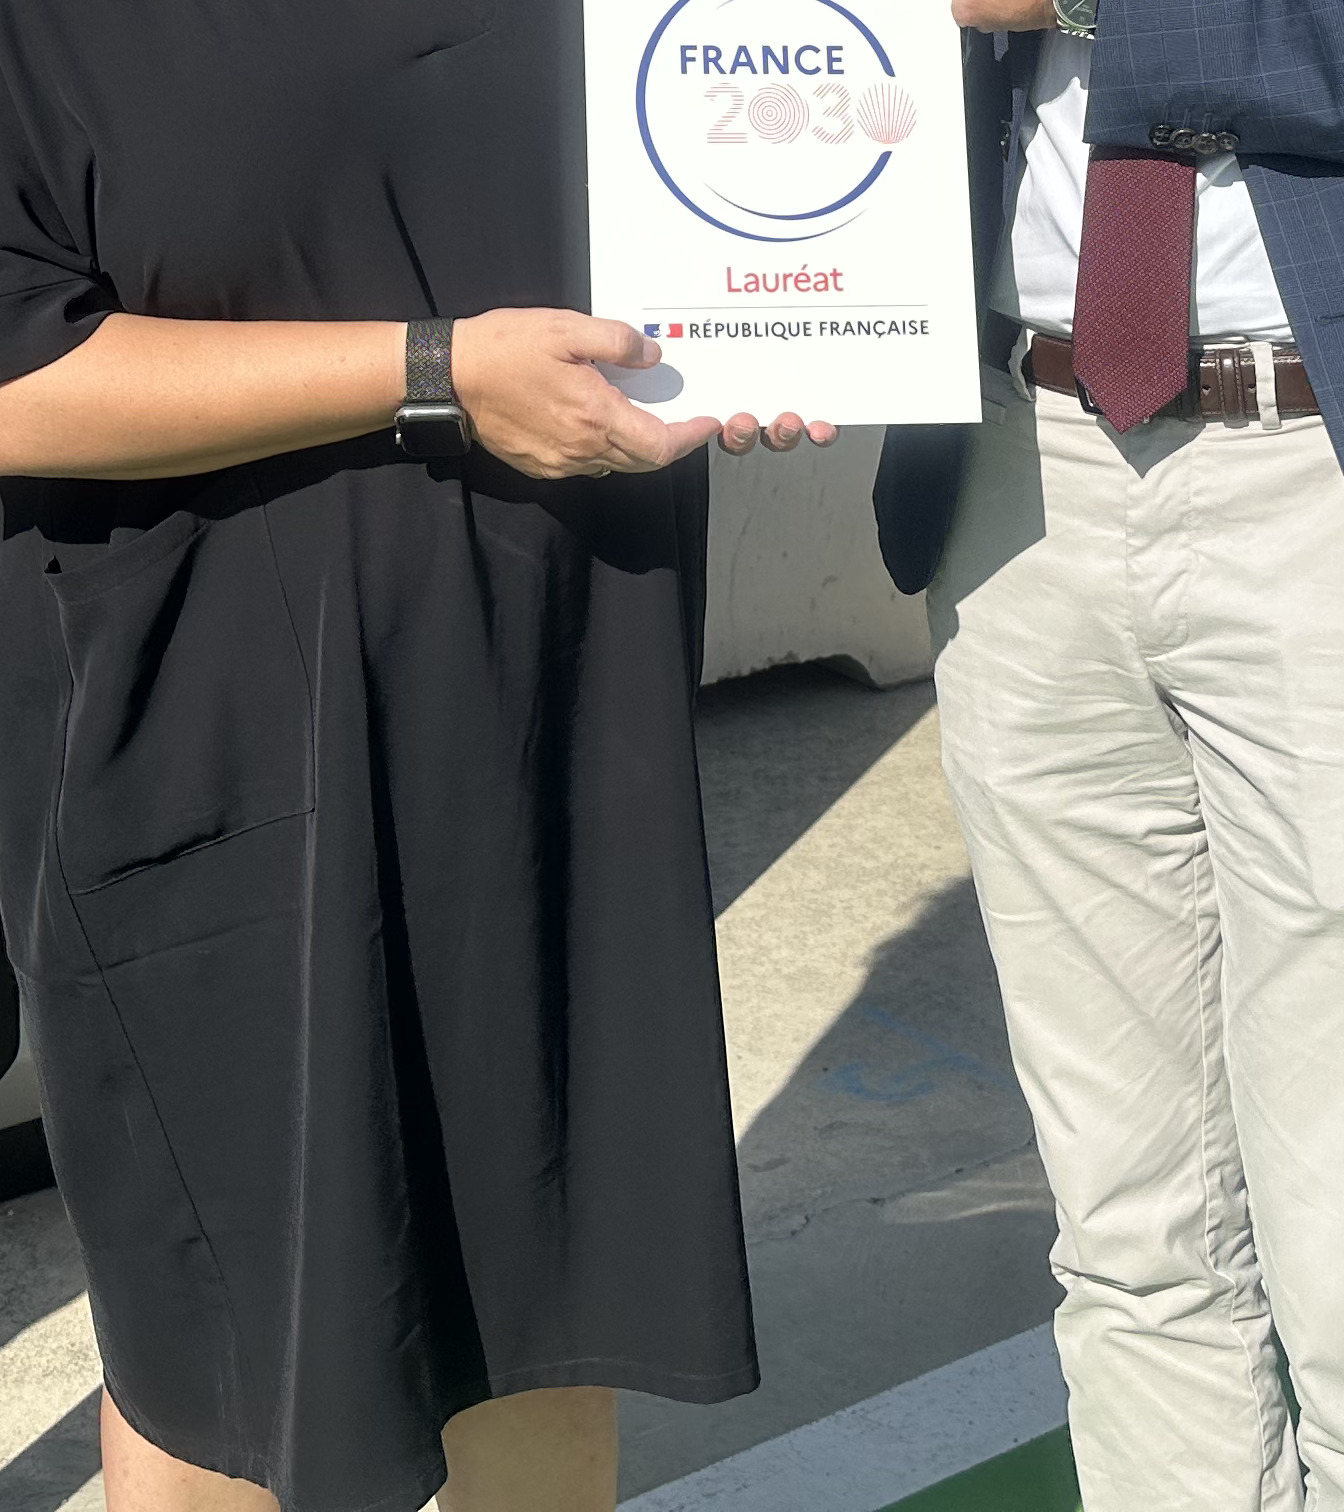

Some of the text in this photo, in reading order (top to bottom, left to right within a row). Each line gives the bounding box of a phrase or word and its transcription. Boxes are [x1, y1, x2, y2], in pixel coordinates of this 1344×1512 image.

[679, 44, 845, 76] FRANCE
[704, 82, 918, 145] 2030
[726, 264, 844, 293] Lauréat
[689, 319, 930, 341] RÉPUBLIQUE FRANÇAISE
